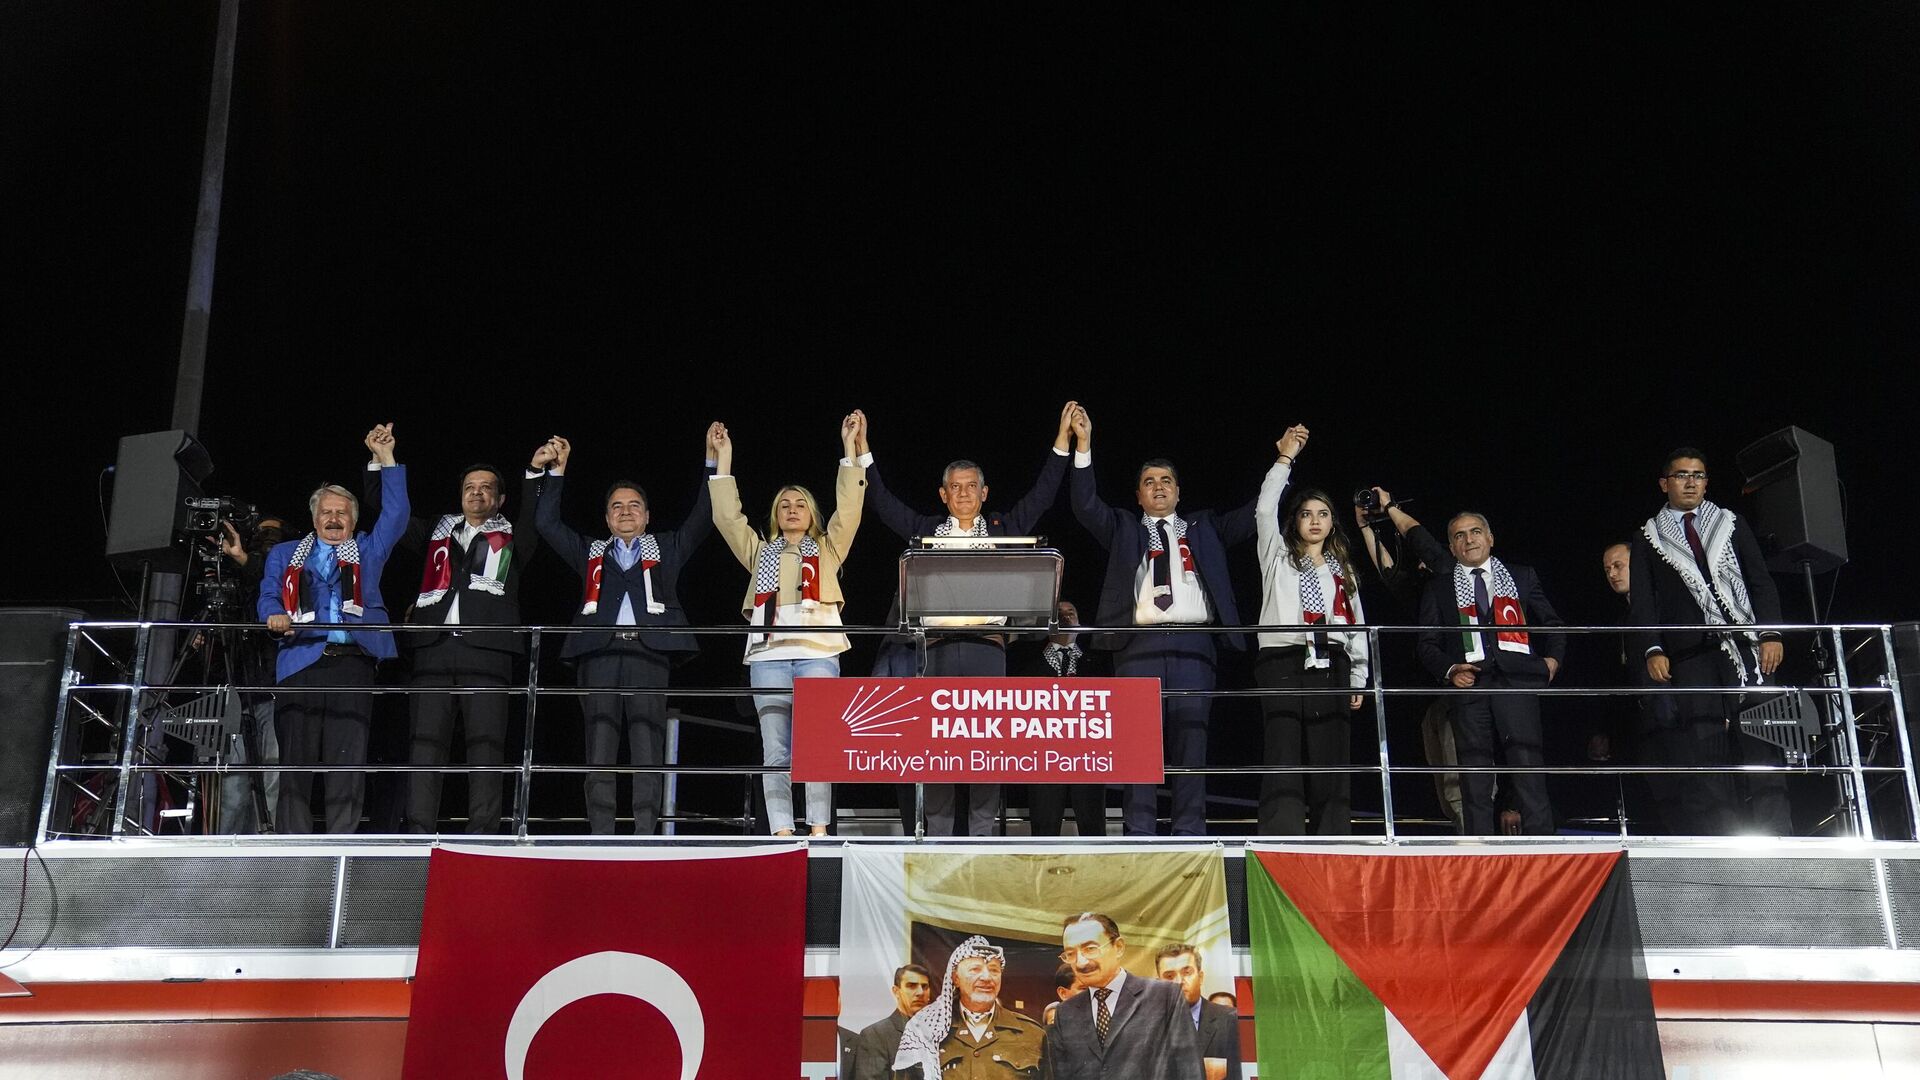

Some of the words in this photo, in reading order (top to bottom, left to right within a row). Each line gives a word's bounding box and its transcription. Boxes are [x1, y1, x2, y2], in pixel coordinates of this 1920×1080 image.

[931, 683, 1112, 711] CUMHURİYET
[931, 717, 1004, 739] HALK
[1011, 711, 1113, 739] PARTİSİ
[970, 749, 1038, 772] Birinci
[1045, 750, 1113, 772] Partisi
